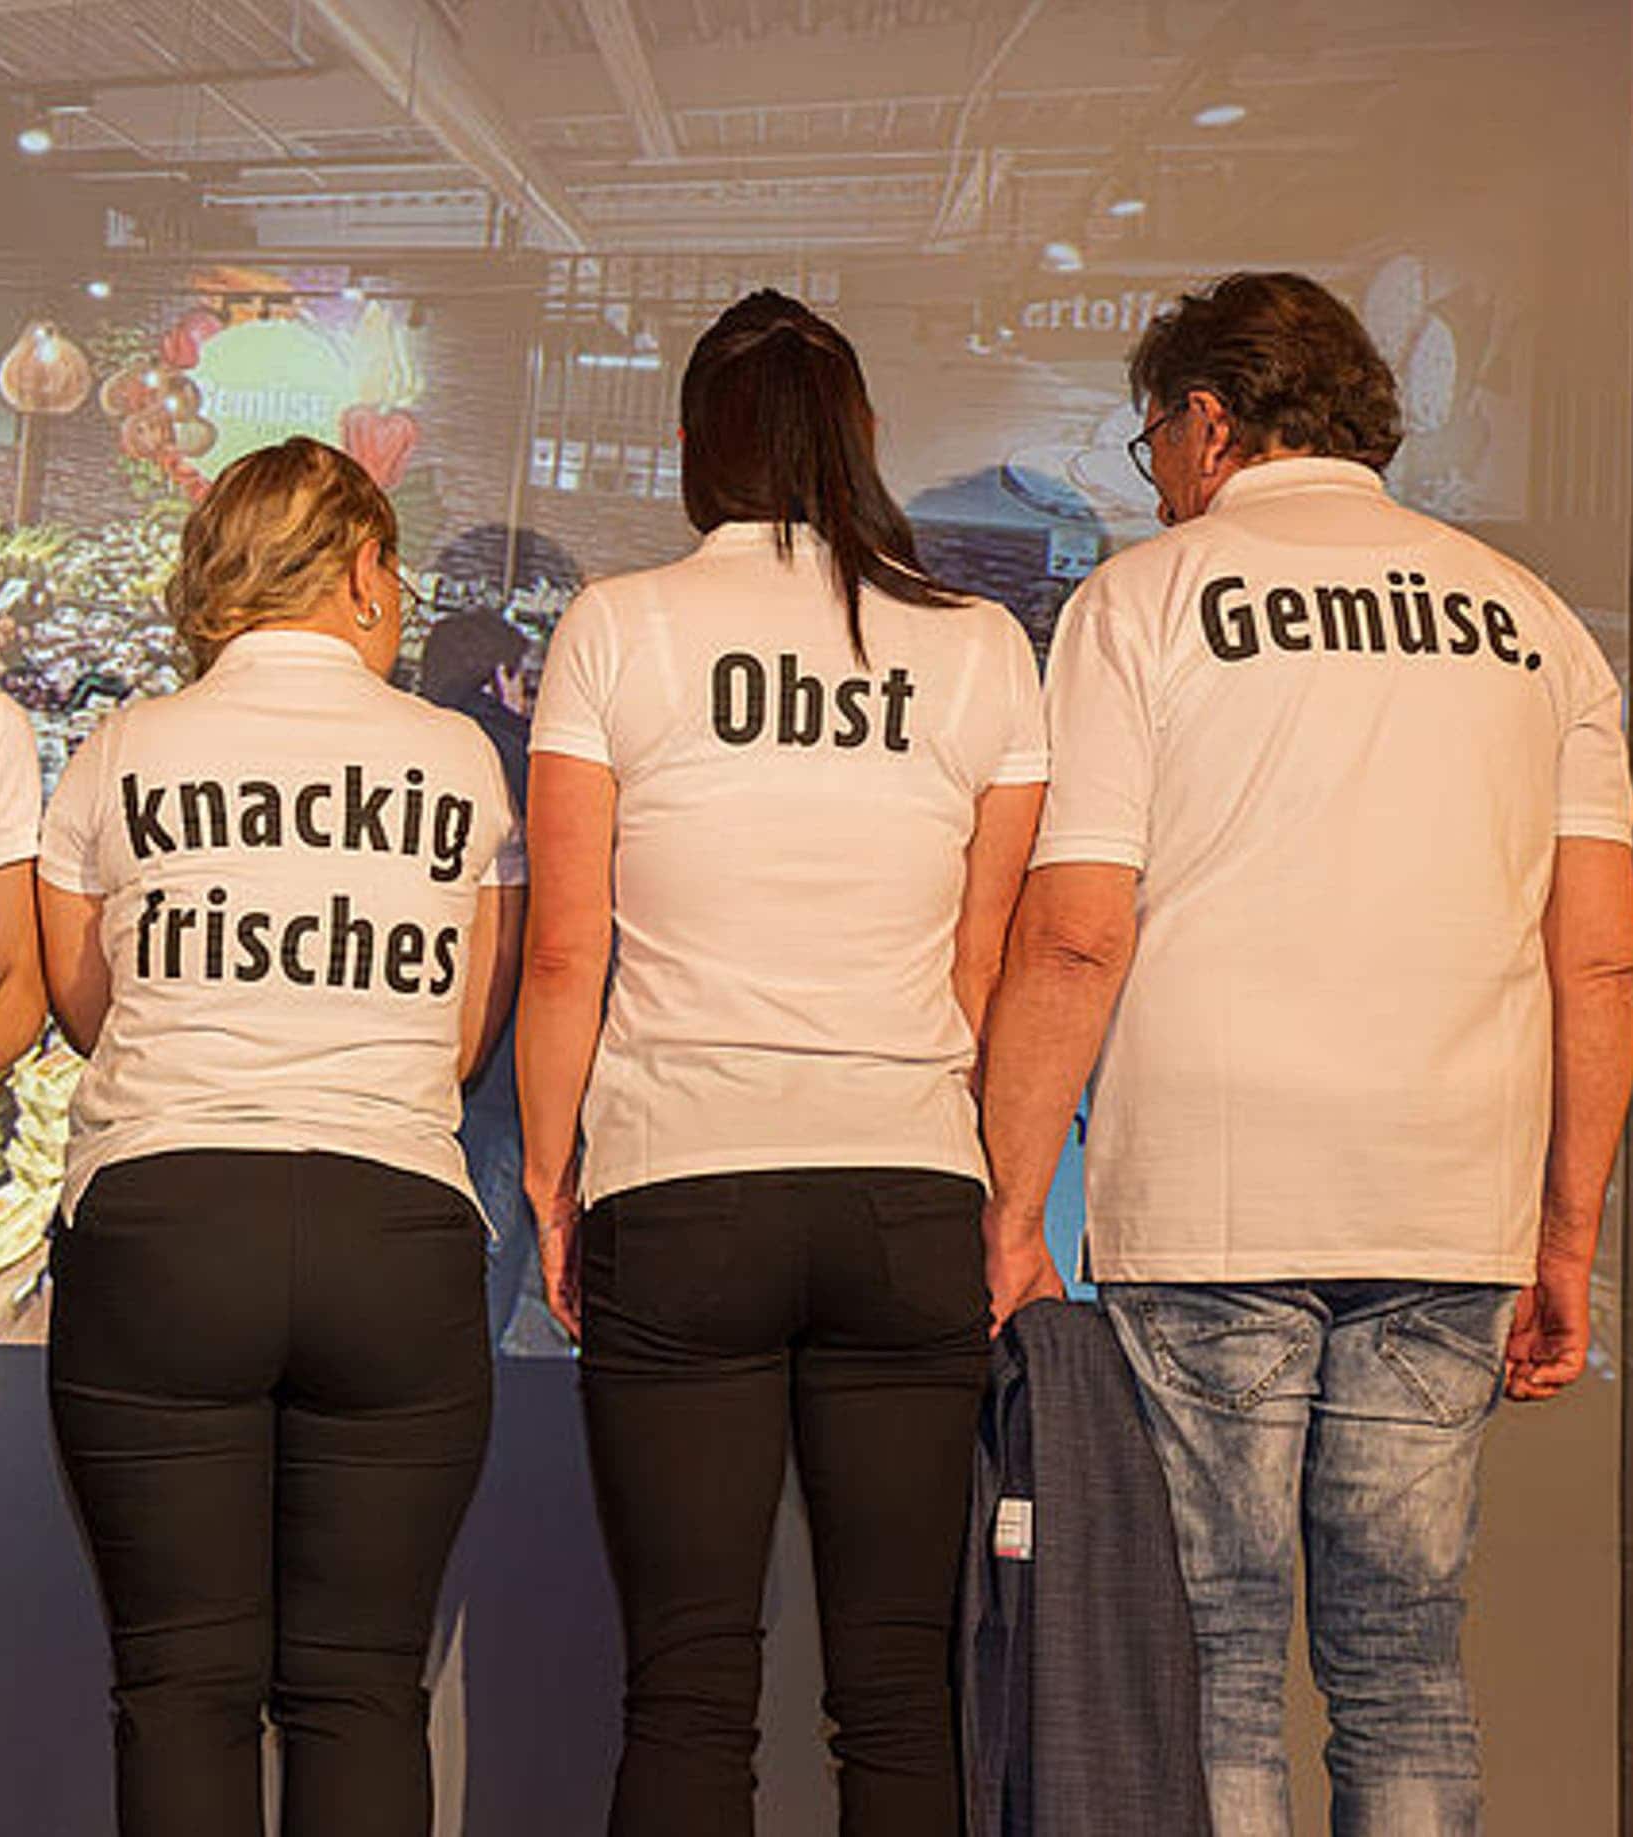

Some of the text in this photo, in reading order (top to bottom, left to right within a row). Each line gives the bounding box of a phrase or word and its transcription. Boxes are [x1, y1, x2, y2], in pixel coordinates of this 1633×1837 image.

[1198, 571, 1543, 673] Gemüse.
[711, 653, 915, 754] Obst
[120, 764, 474, 884] knackig
[135, 887, 459, 996] frisches
